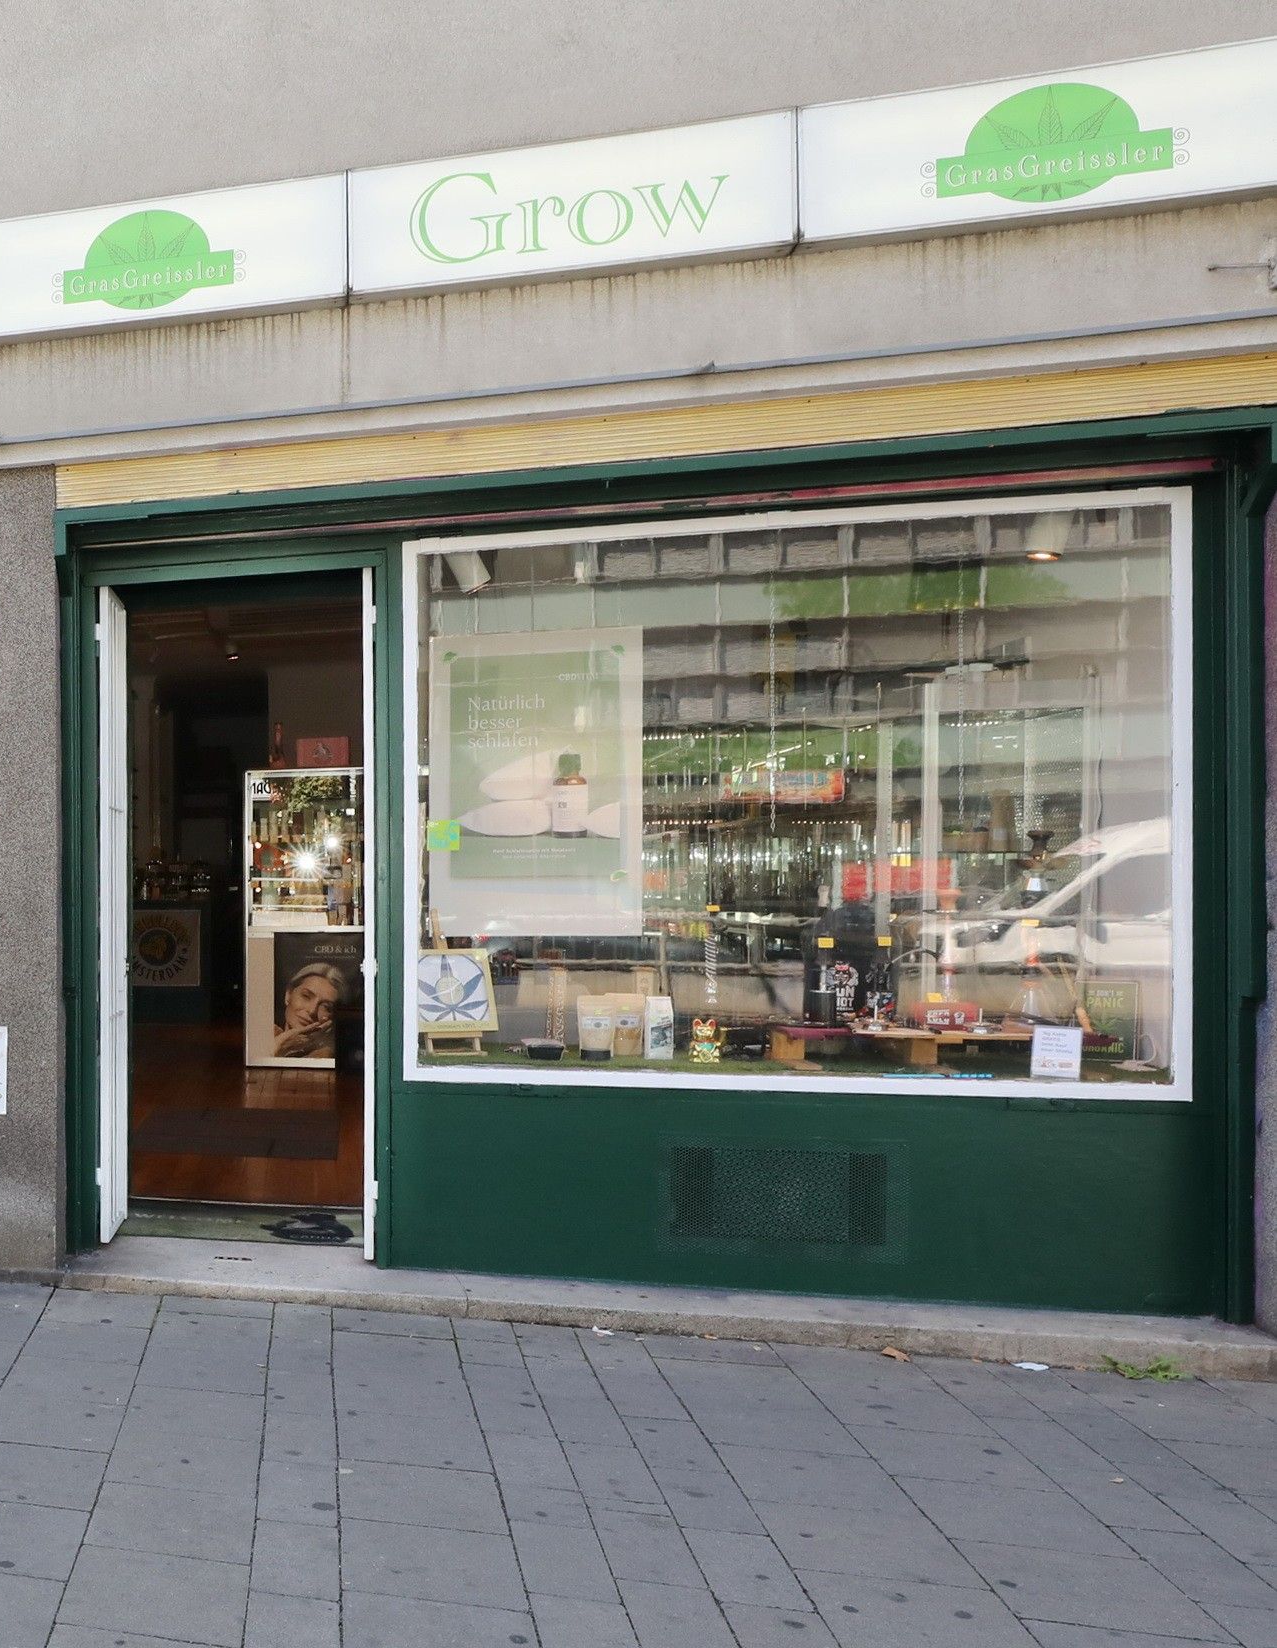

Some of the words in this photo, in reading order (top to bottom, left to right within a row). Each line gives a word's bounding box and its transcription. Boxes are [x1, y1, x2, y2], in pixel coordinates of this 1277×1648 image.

[943, 139, 1167, 187] GrasGreissler
[409, 172, 730, 265] Grow
[69, 259, 229, 298] GrasGreissler
[468, 694, 546, 712] Natürlich
[468, 715, 523, 732] besser
[468, 731, 539, 748] schlafen
[1086, 996, 1124, 1009] PANIC
